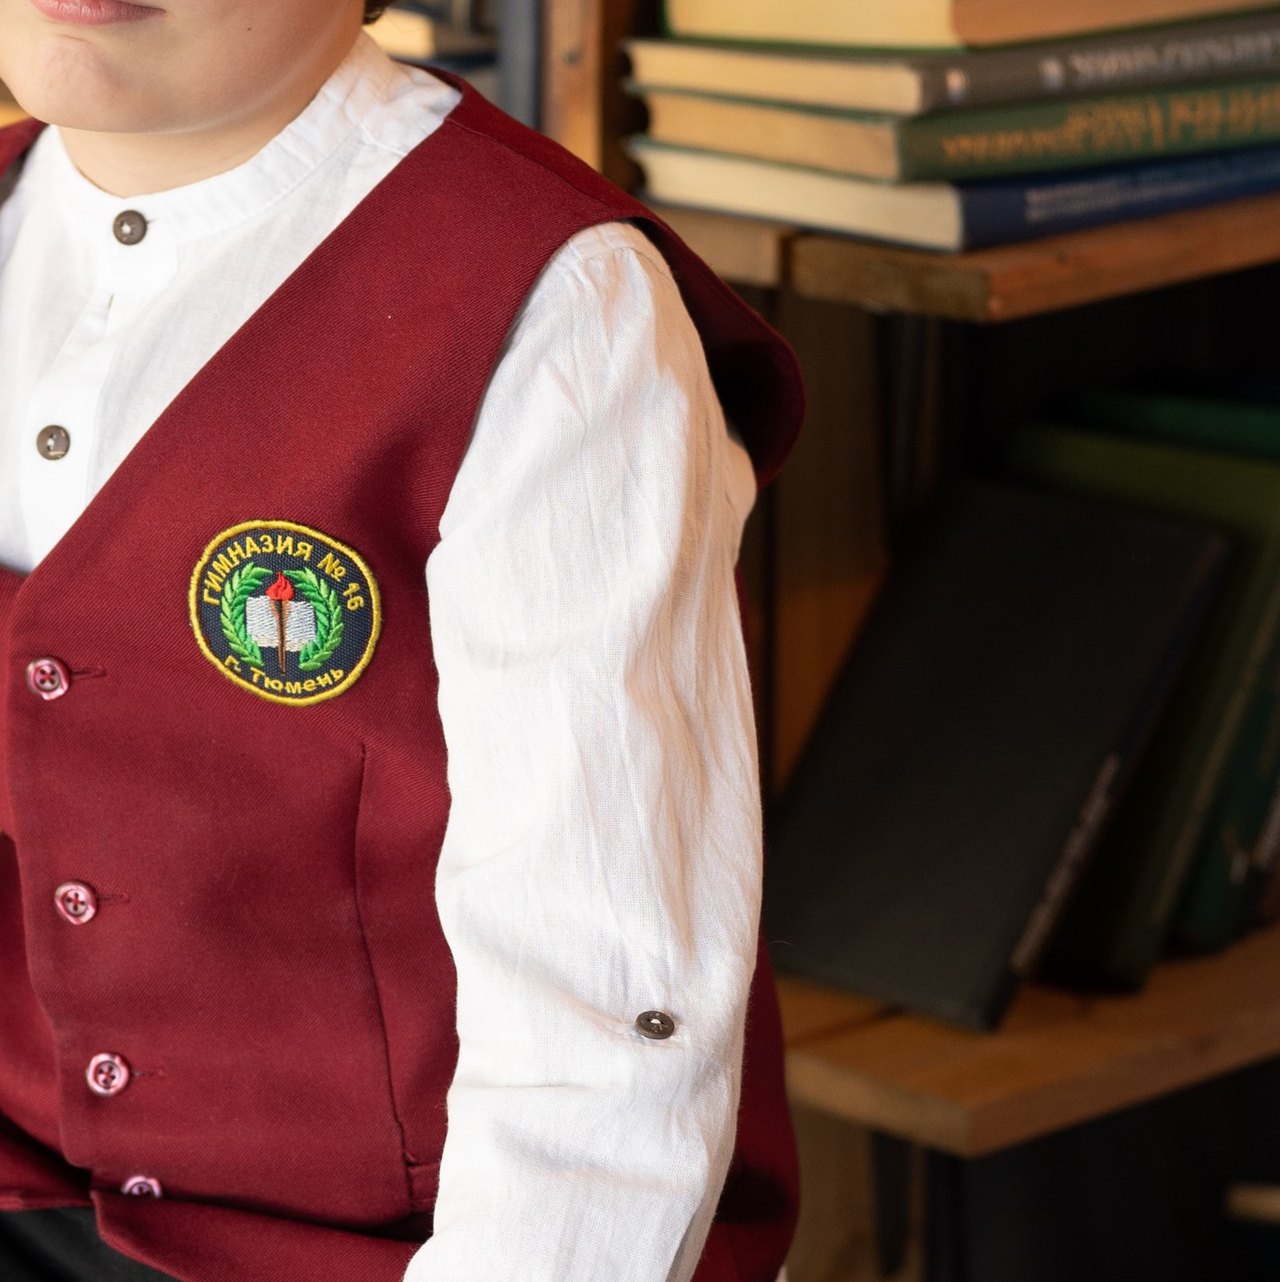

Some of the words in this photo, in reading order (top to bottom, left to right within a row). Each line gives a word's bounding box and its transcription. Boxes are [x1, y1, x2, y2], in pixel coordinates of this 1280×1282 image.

[203, 534, 313, 606] ГИМНАЗИЯ
[317, 552, 346, 582] №
[249, 666, 345, 694] Тюмень
